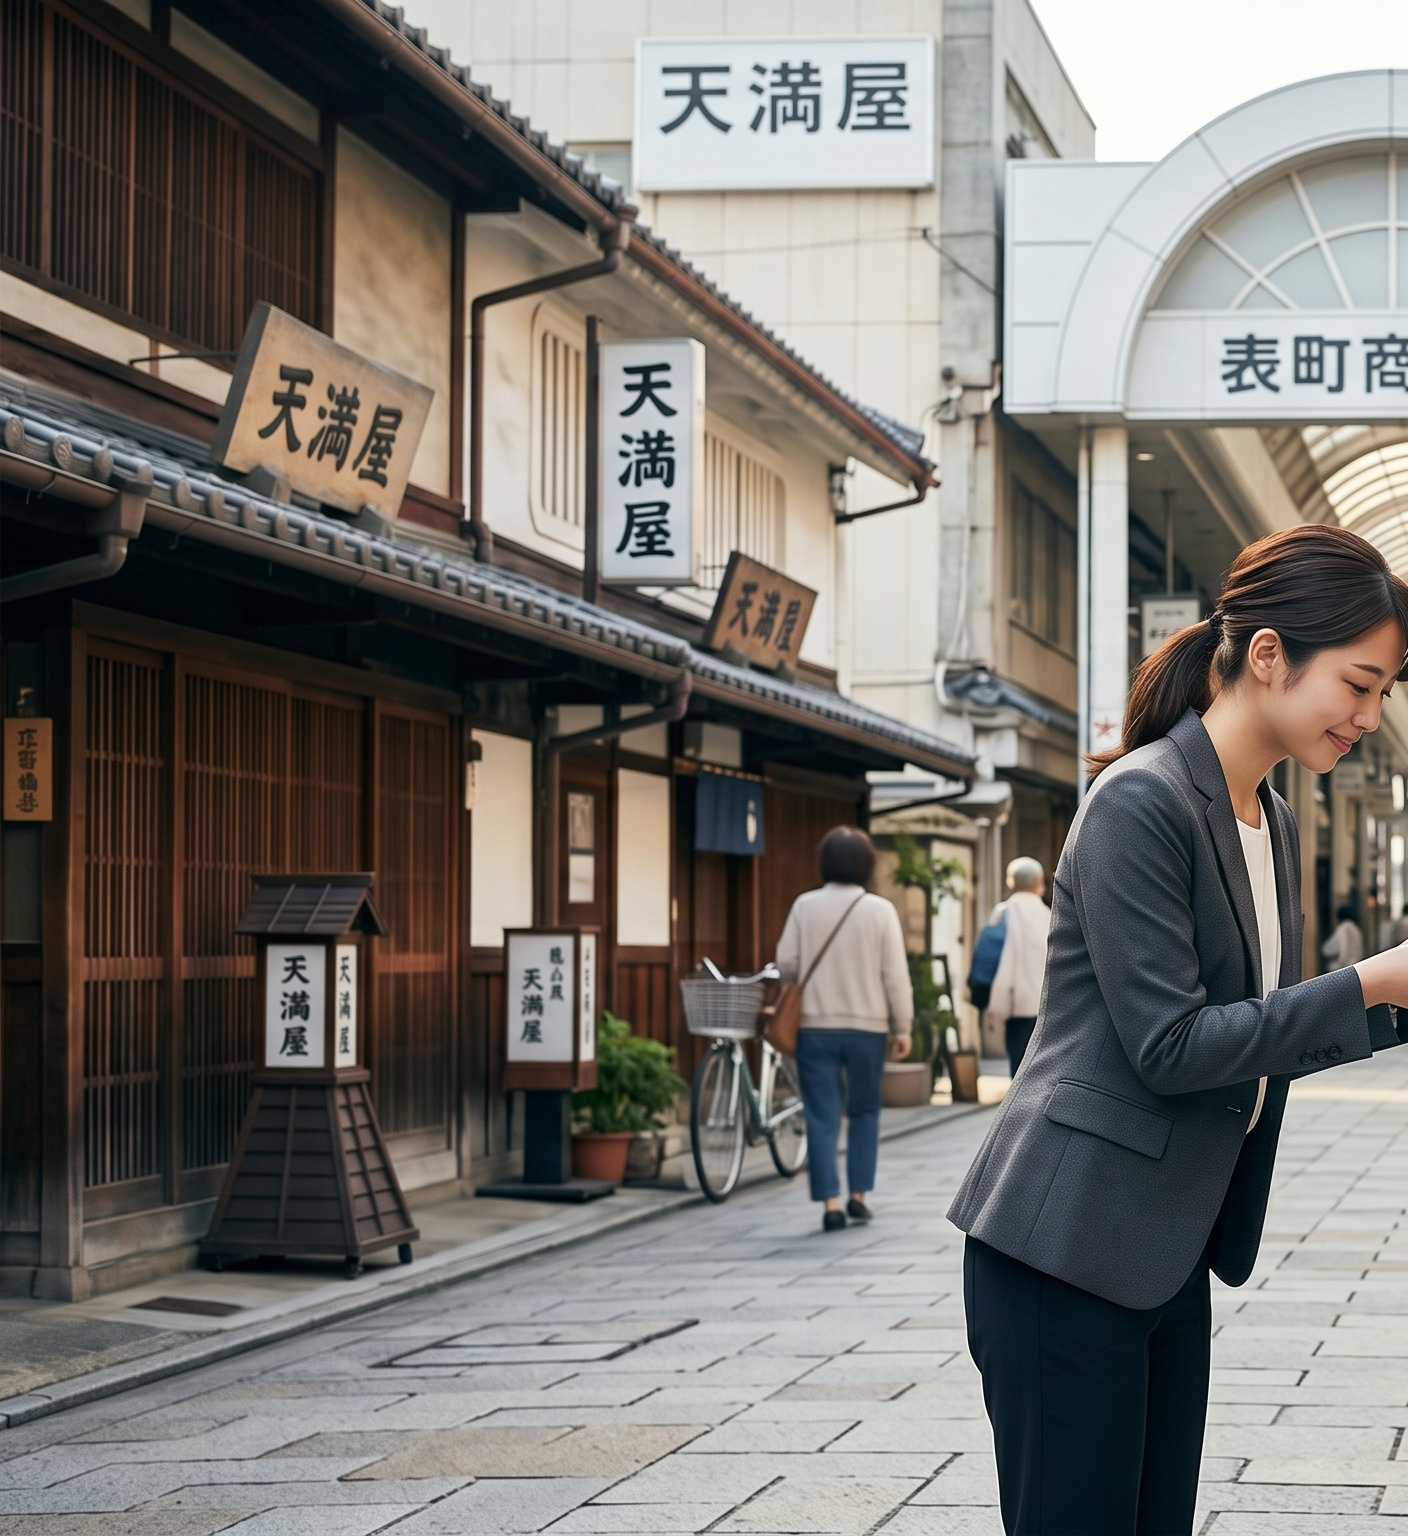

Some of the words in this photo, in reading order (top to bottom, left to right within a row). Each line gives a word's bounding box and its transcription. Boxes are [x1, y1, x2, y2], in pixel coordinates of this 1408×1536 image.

[661, 61, 911, 135] 天満屋
[257, 363, 403, 489] 天満屋
[616, 362, 678, 559] 天満屋
[727, 582, 802, 652] 天満屋
[279, 954, 311, 1057] 天満屋
[520, 968, 544, 1044] 天満屋
